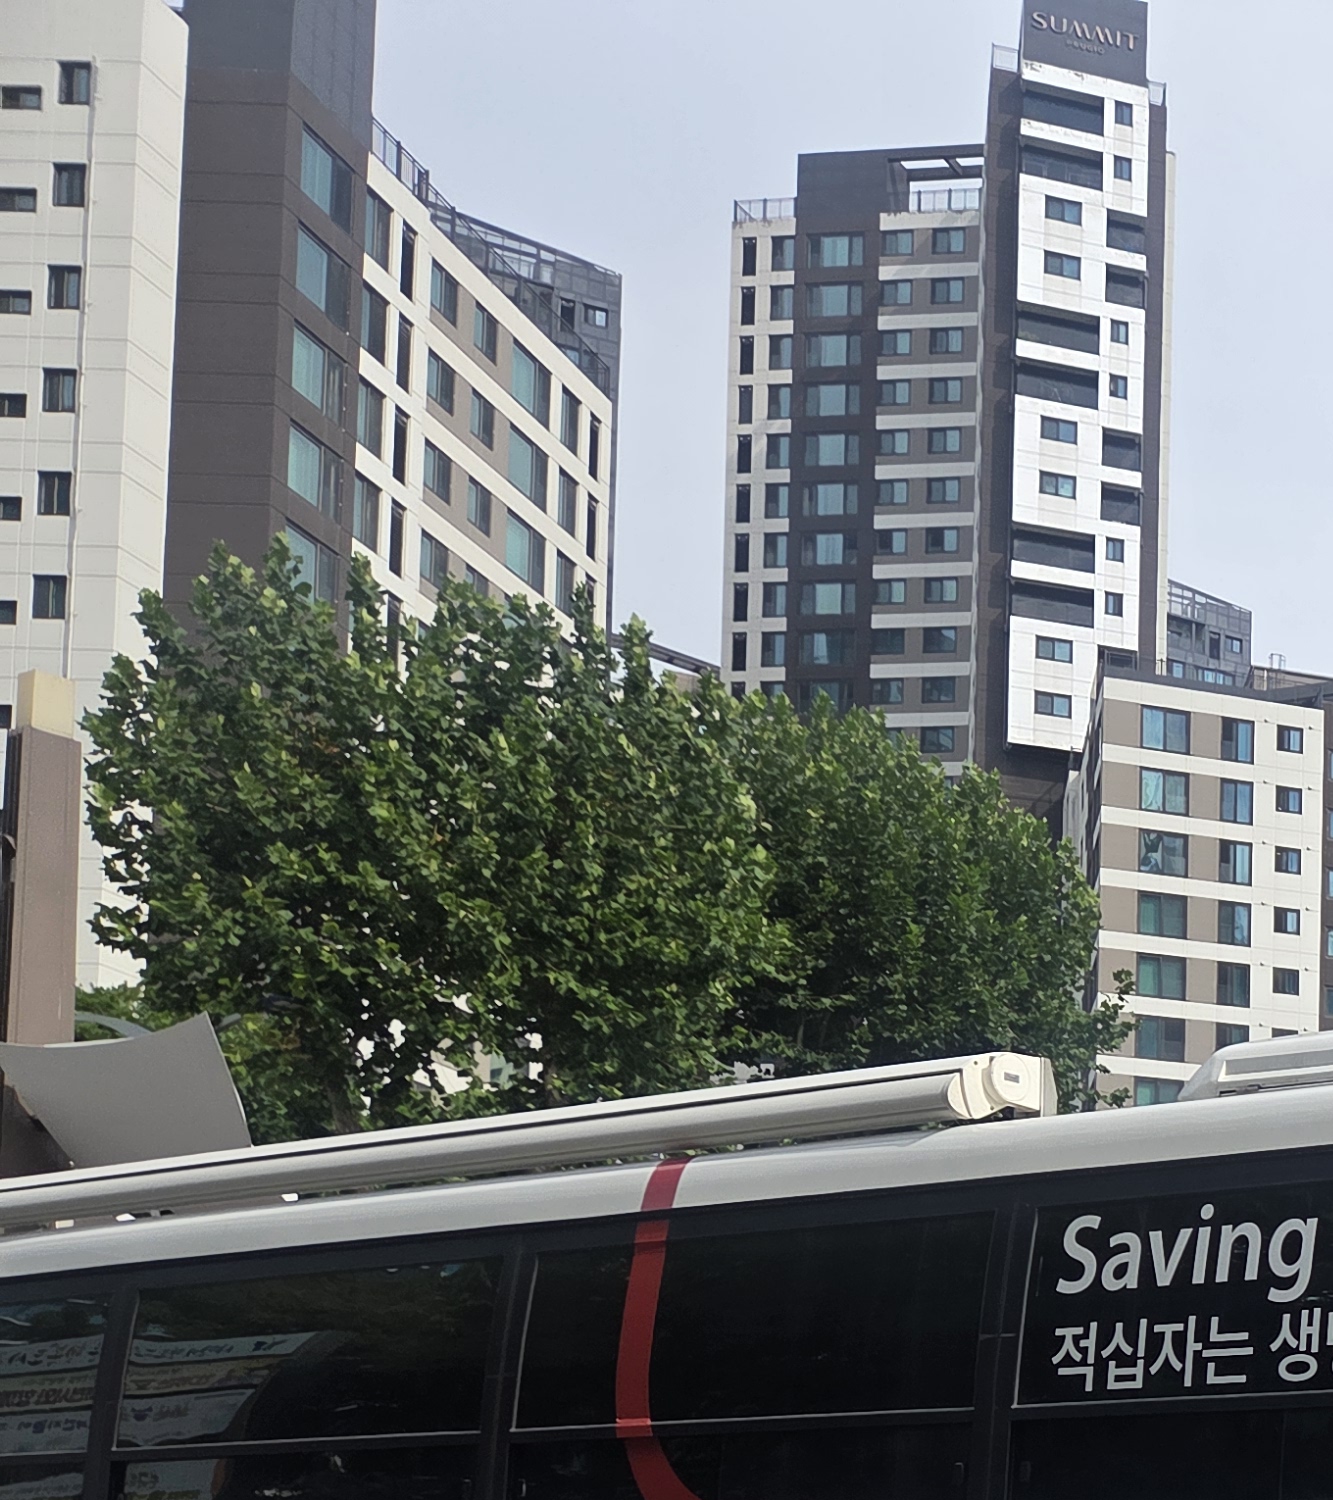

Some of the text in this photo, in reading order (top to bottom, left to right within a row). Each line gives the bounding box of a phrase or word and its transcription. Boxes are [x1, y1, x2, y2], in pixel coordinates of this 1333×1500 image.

[1032, 11, 1139, 51] SUMMIT
[1056, 1202, 1318, 1302] Saving
[1051, 1313, 1254, 1392] 적십자는
